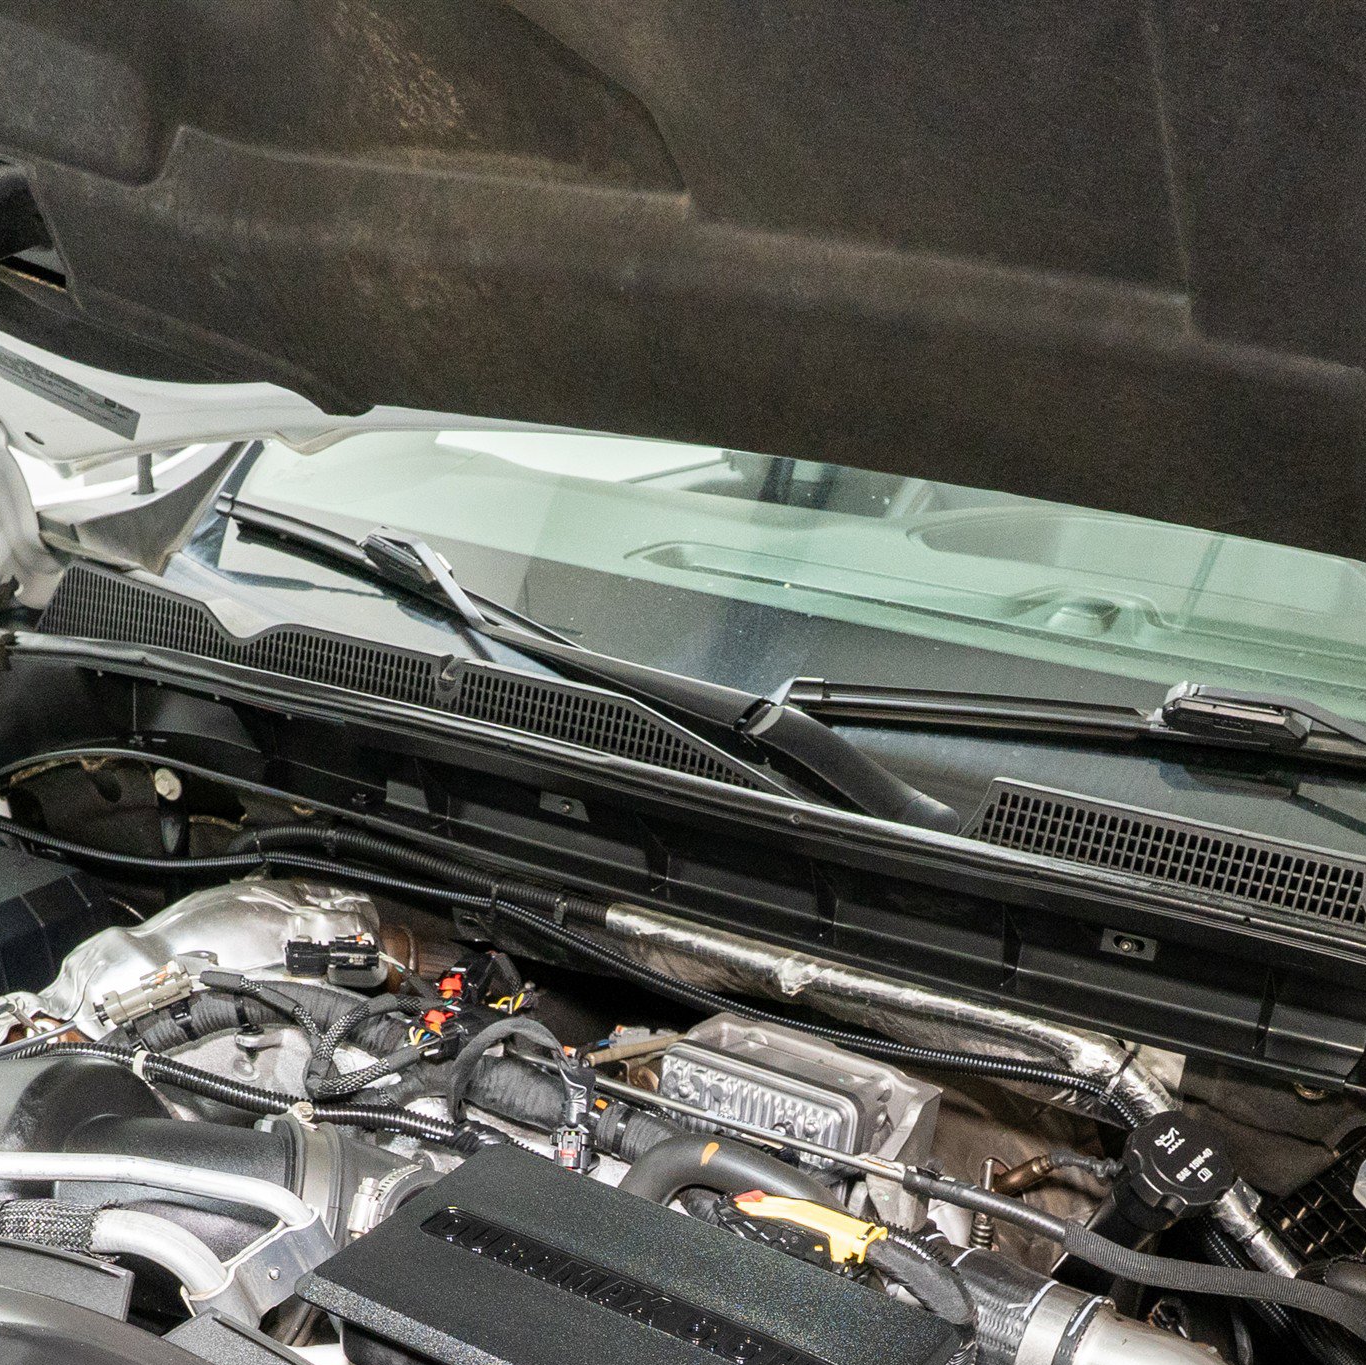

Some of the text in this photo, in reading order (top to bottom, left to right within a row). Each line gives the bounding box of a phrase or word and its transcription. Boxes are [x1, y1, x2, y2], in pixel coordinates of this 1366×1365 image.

[1176, 1148, 1213, 1182] SAE 15W-40
[433, 1207, 673, 1328] DURAMAX
